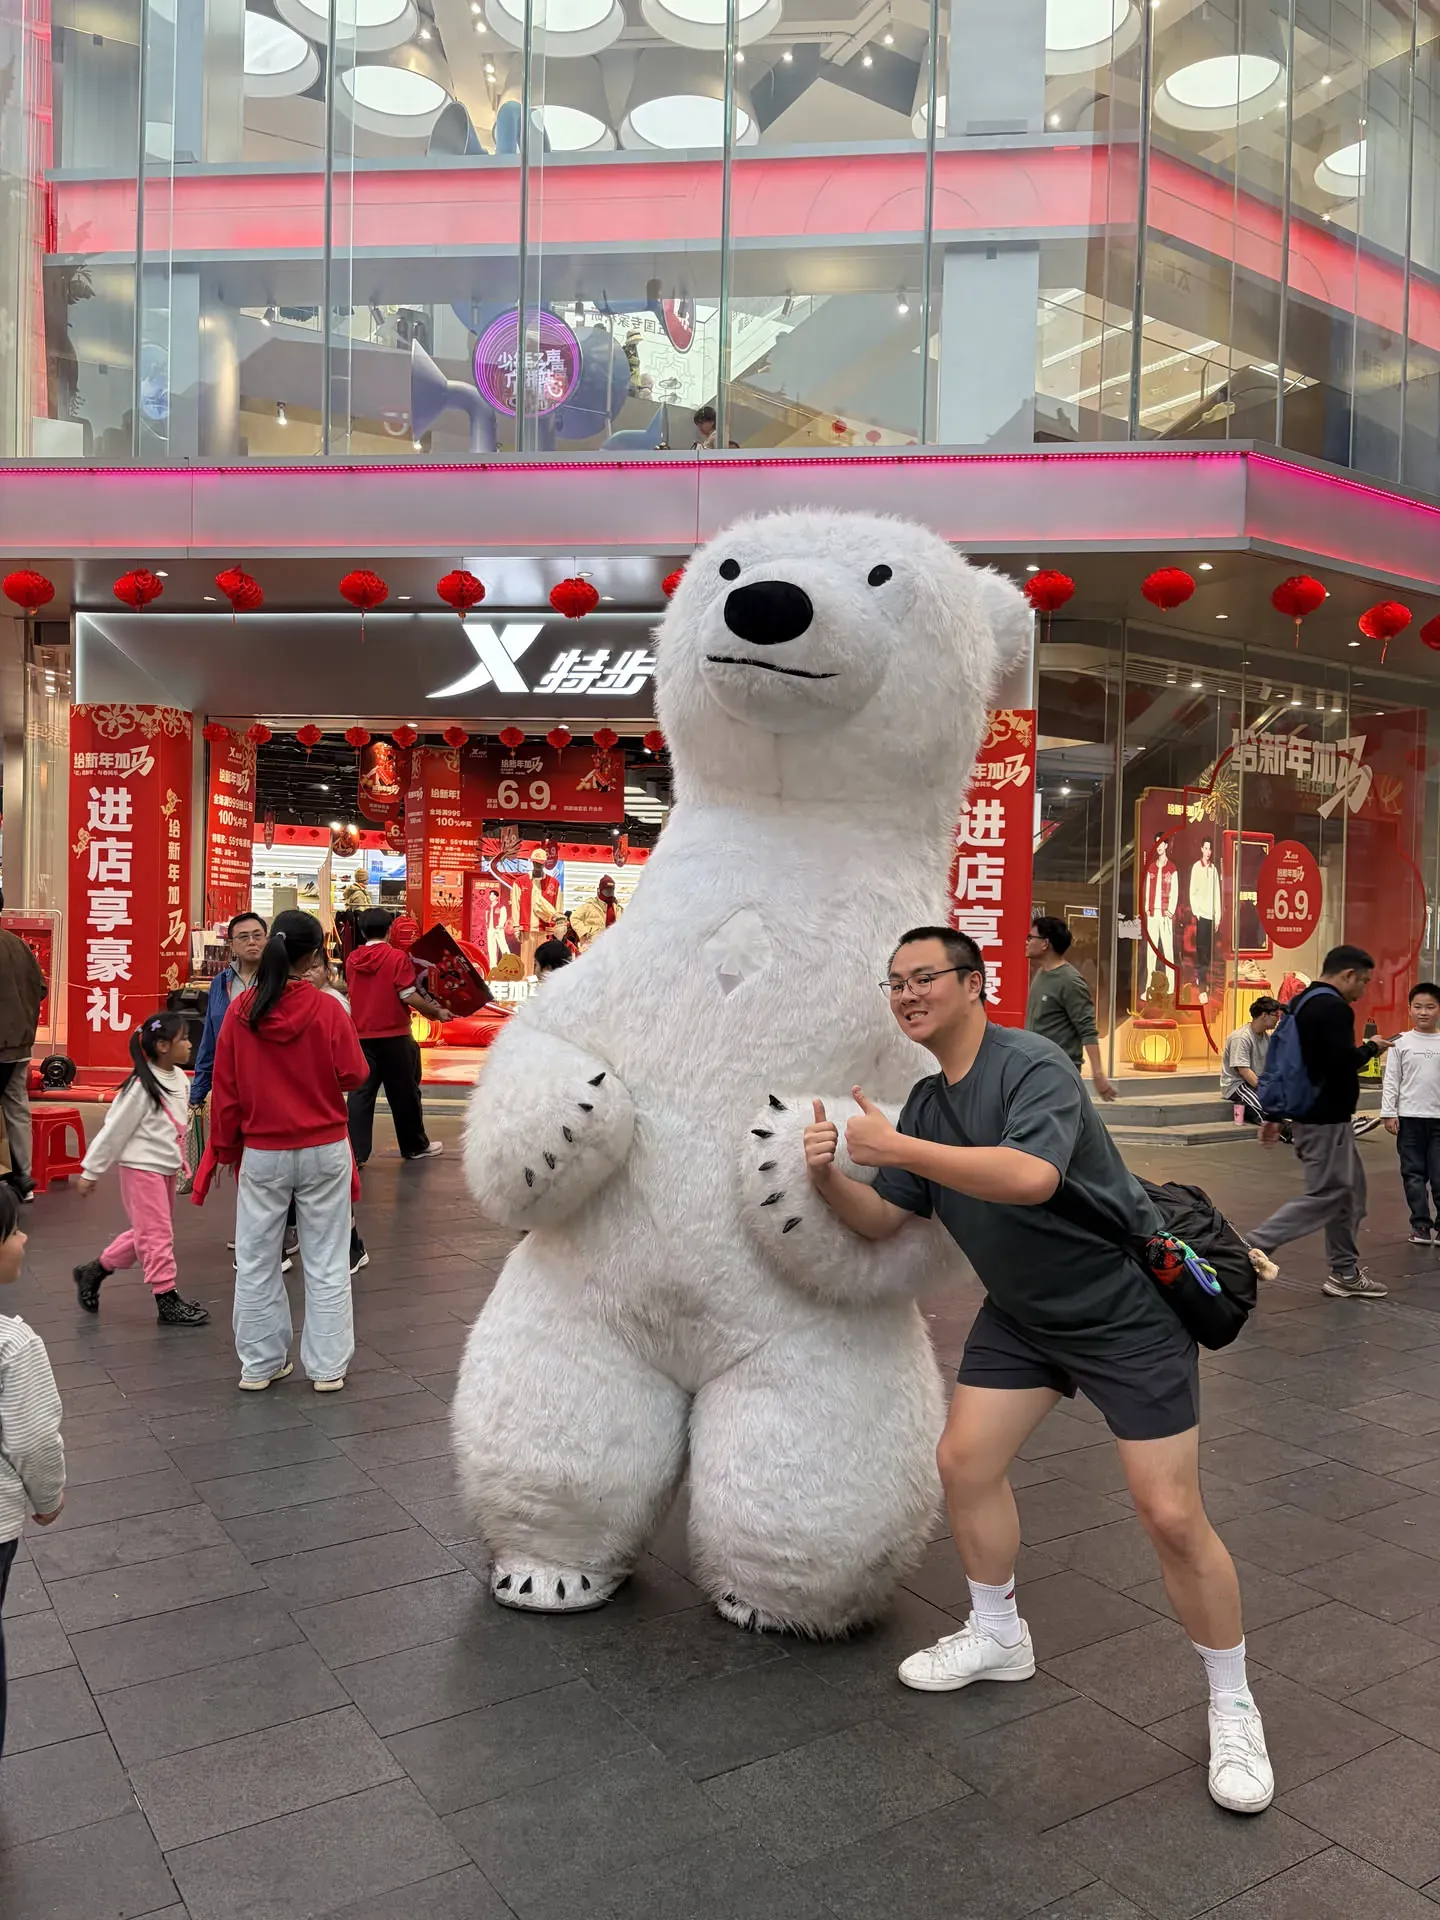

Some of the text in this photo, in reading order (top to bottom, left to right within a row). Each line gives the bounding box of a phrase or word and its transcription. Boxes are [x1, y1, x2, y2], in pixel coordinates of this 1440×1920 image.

[425, 624, 657, 698] X 特步
[73, 745, 155, 779] 给新年加马
[501, 756, 544, 774] 给新年加马
[1231, 728, 1373, 820] 给新年加马
[219, 768, 250, 794] 给新年加马
[497, 780, 551, 810] 6.9
[436, 817, 473, 827] 100%中奖
[160, 818, 188, 949] 给新年加马
[86, 786, 133, 1033] 进店享豪礼
[1273, 889, 1309, 920] 6.9
